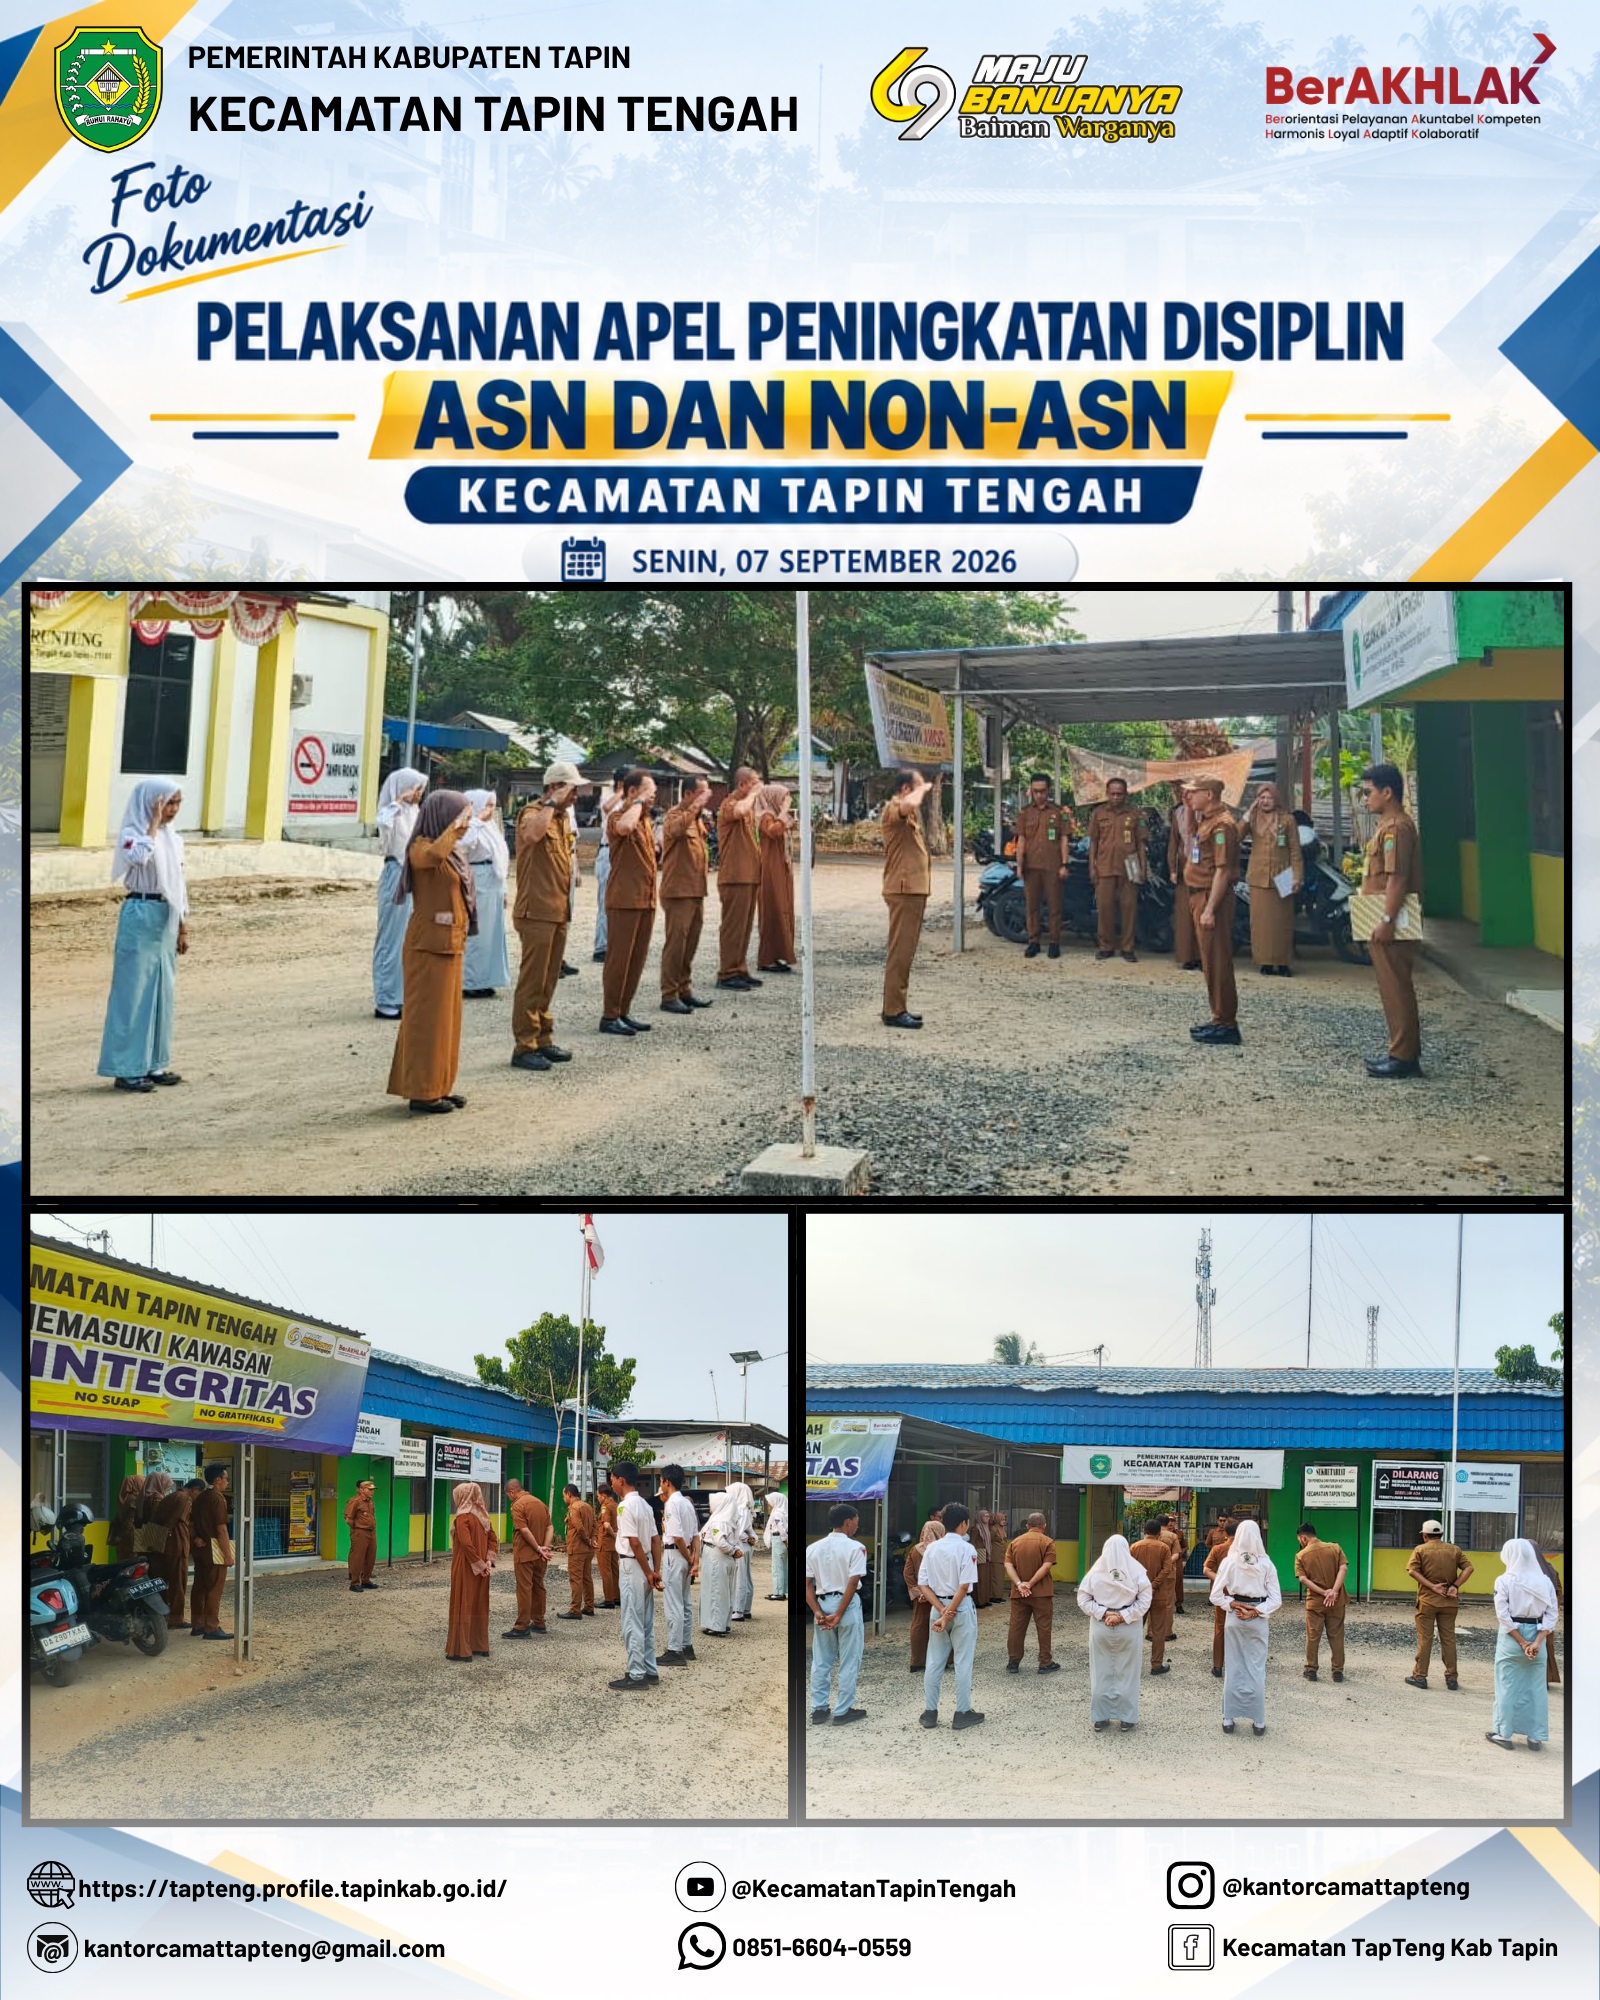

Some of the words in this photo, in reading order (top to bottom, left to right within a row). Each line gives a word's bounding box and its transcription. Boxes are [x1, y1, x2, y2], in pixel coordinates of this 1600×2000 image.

[136, 1291, 201, 1327] TAPIN
[206, 1310, 278, 1346] TENGAH
[168, 1334, 272, 1376] KAWASAN
[30, 1339, 317, 1415] INTEGRITAS
[74, 1391, 98, 1402] NO
[101, 1395, 141, 1408] SUAP
[199, 1409, 216, 1418] NO
[217, 1411, 275, 1425] GRATIFIKASI
[1123, 1460, 1181, 1468] KECAMATAN
[1184, 1461, 1211, 1469] TAPIN
[1214, 1461, 1253, 1469] TENGAH
[1392, 1470, 1439, 1480] DILARANG
[43, 1637, 54, 1647] DA
